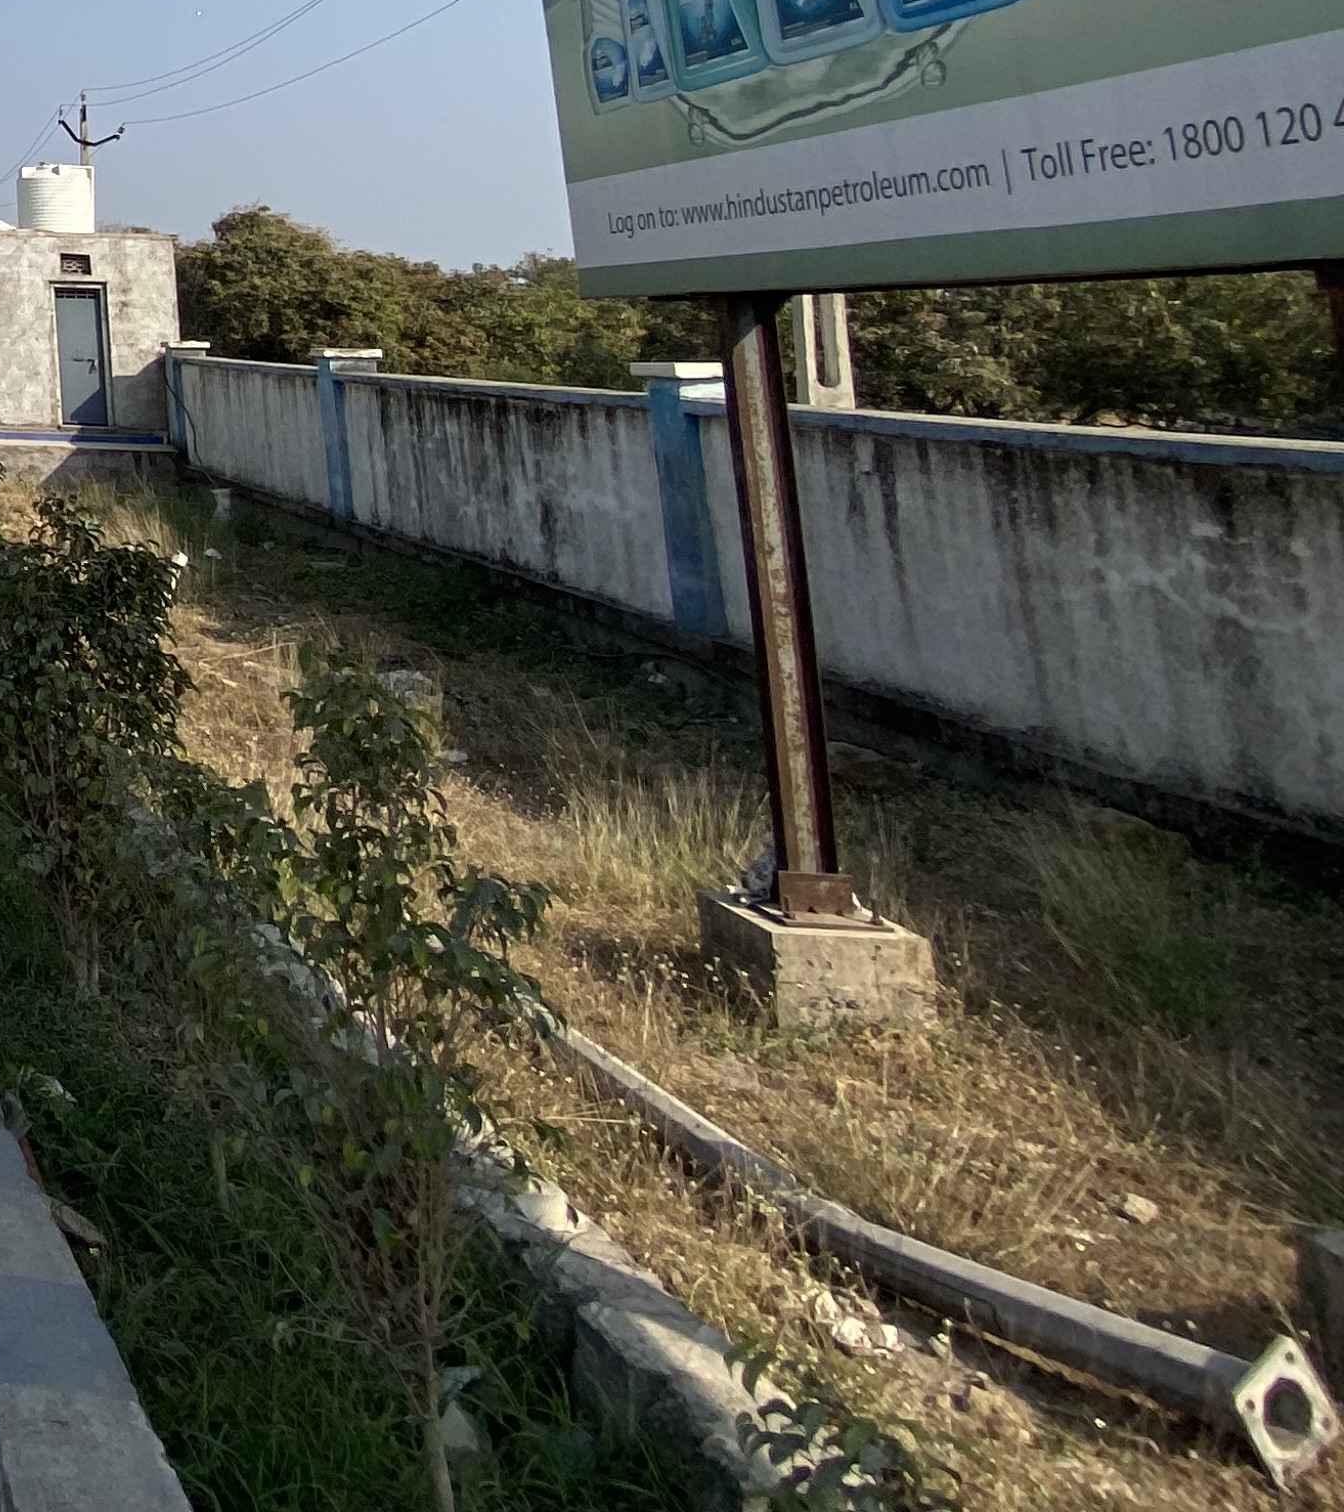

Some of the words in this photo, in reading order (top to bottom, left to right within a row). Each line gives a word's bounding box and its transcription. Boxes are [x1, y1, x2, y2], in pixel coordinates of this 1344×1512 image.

[608, 212, 634, 239] Log
[637, 211, 656, 231] on
[659, 207, 679, 228] to:
[681, 163, 990, 226] www.hindustanpetroleum.com
[1020, 140, 1073, 181] Toll
[1081, 138, 1156, 174] Free:
[1162, 116, 1244, 161] 1800
[1255, 103, 1322, 148] 120
